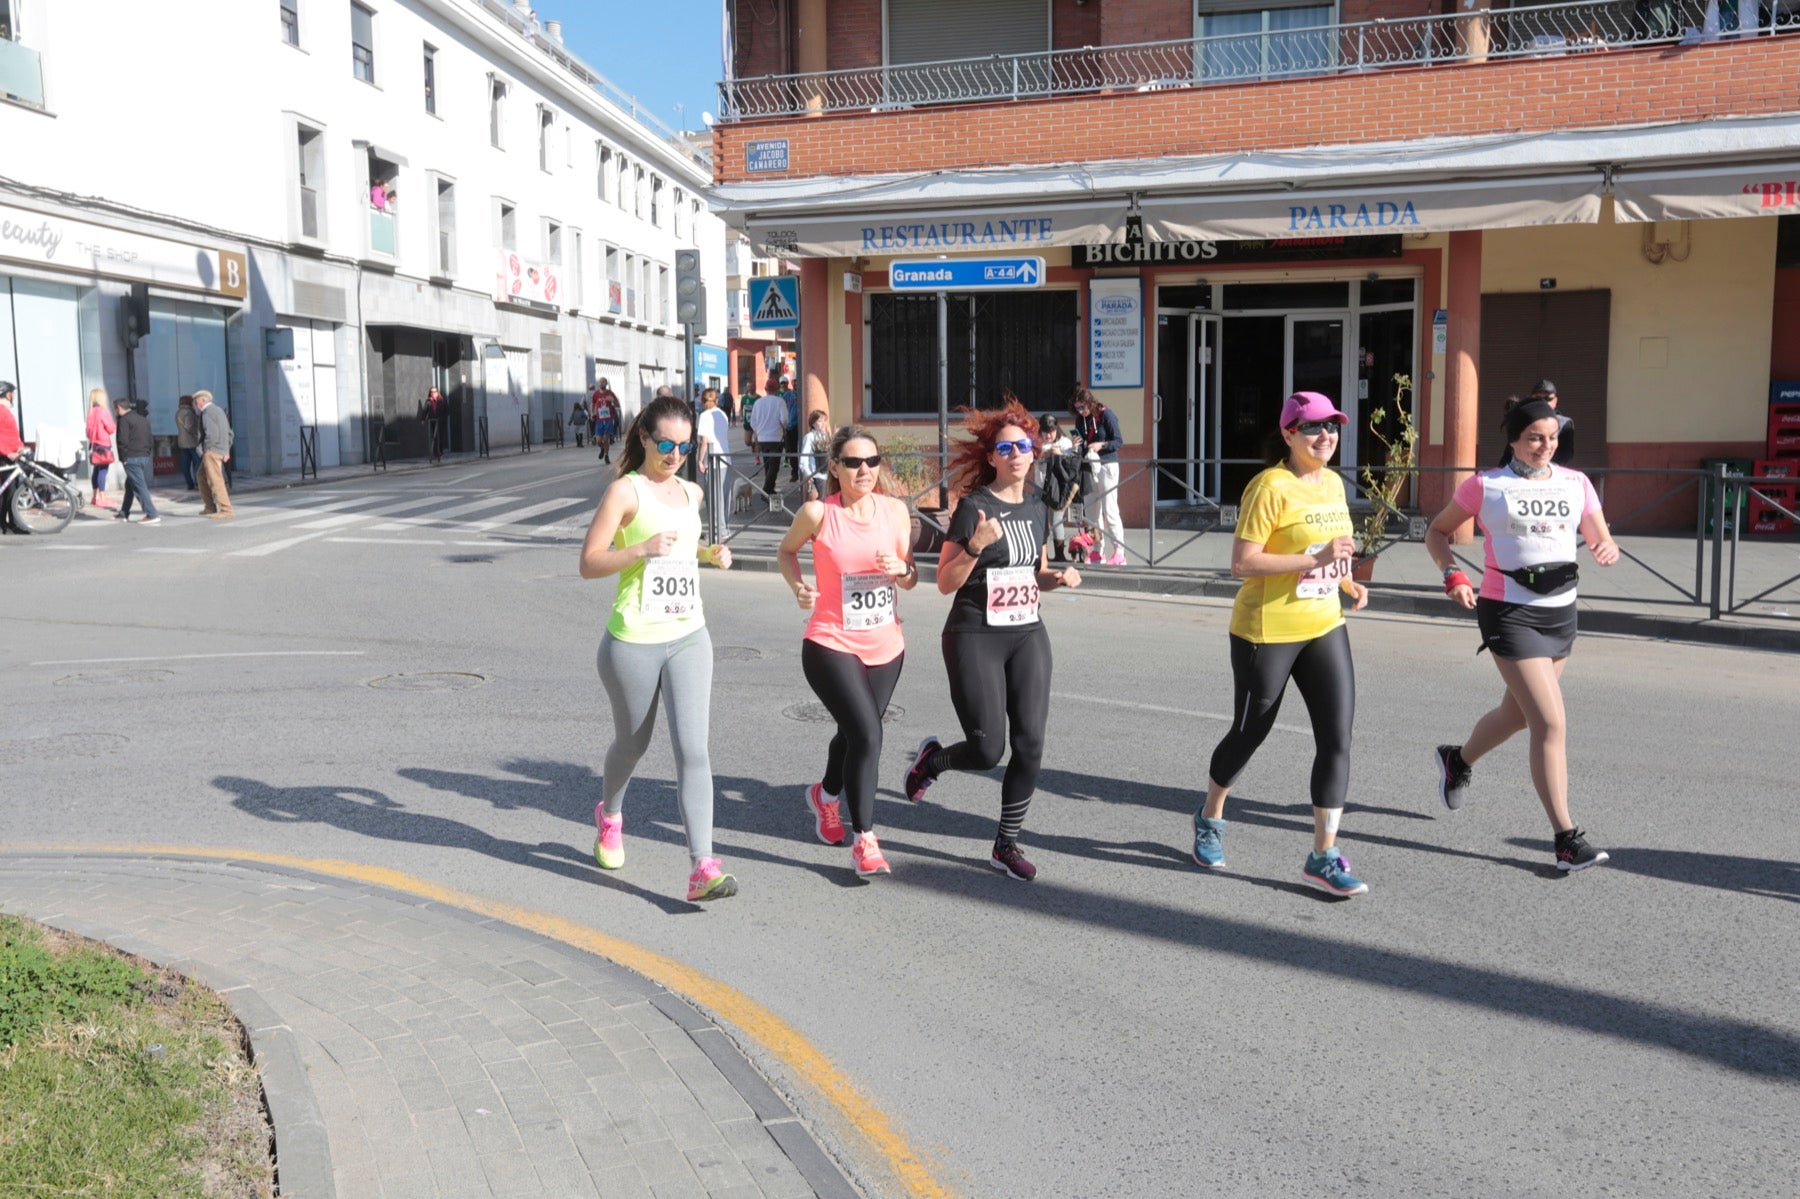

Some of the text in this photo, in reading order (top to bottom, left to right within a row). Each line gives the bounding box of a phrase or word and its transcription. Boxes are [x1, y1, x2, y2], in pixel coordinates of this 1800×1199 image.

[756, 141, 787, 151] AVENIDA
[758, 150, 785, 160] JACOBO
[749, 159, 788, 171] CAMARERO
[1288, 200, 1421, 231] PARADA
[0, 220, 63, 260] eauty
[861, 217, 1056, 250] RESTAURANTE
[75, 241, 139, 264] THE SHOP
[1085, 241, 1219, 262] BICHITOS
[226, 258, 241, 288] B
[894, 266, 953, 282] Granada
[1101, 302, 1133, 310] PARADA
[1517, 499, 1570, 517] 3026
[652, 576, 695, 597] 3031
[992, 585, 1040, 607] 2233
[851, 586, 893, 610] 3039
